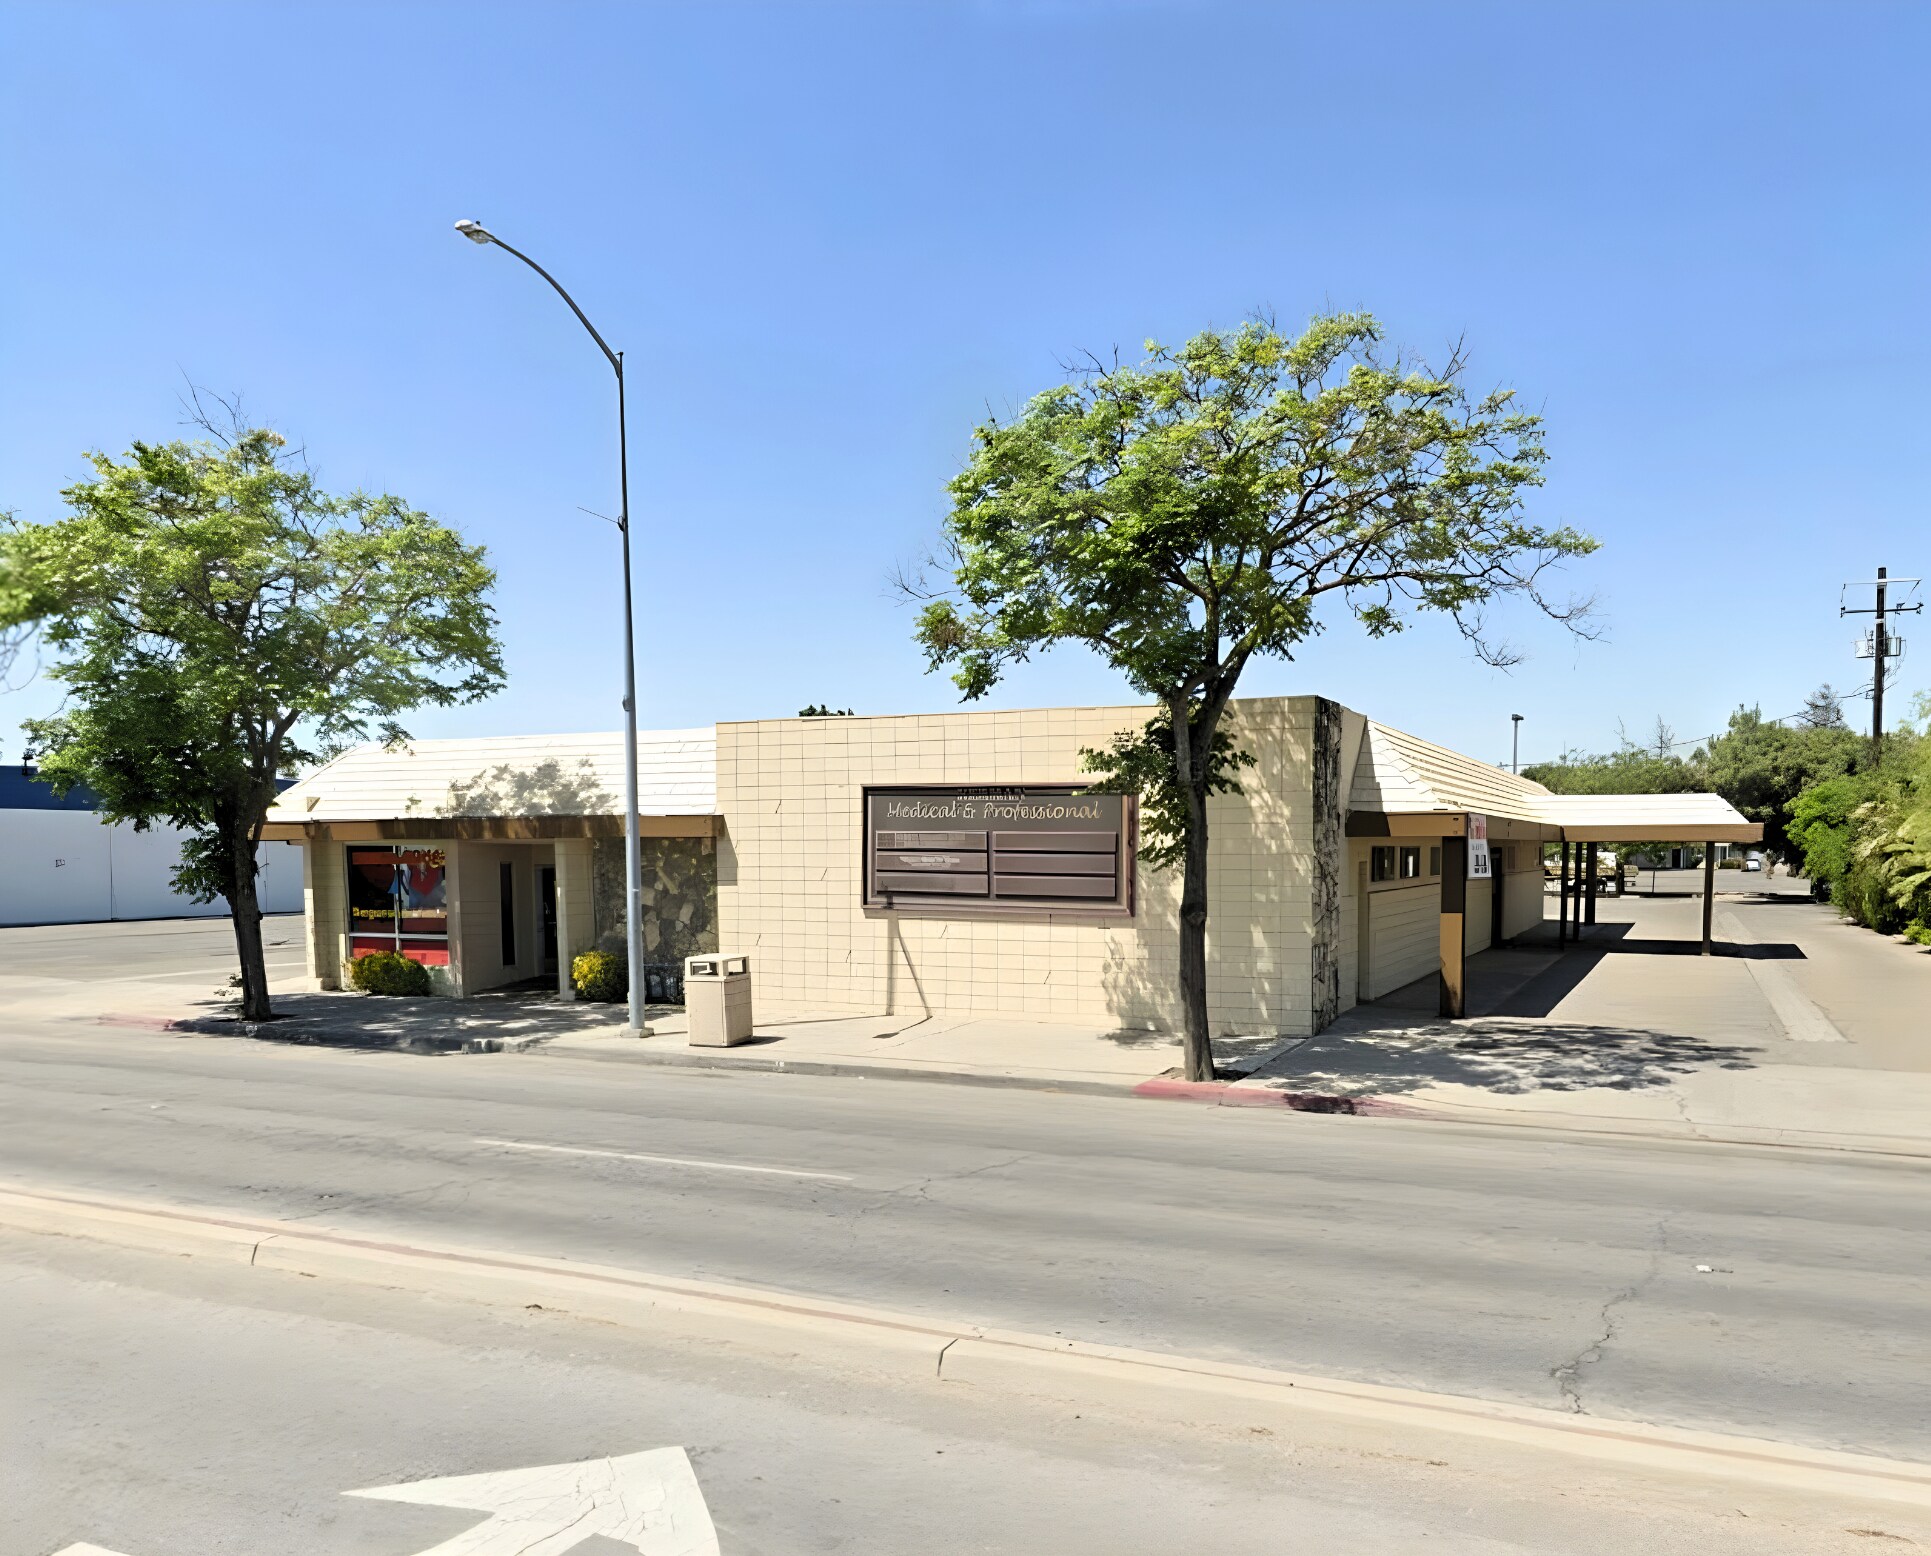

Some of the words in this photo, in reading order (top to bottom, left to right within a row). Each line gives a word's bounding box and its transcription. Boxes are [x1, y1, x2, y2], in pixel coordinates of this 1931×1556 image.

[887, 801, 957, 818] Medical
[963, 803, 976, 818] &
[984, 801, 1102, 820] Professional
